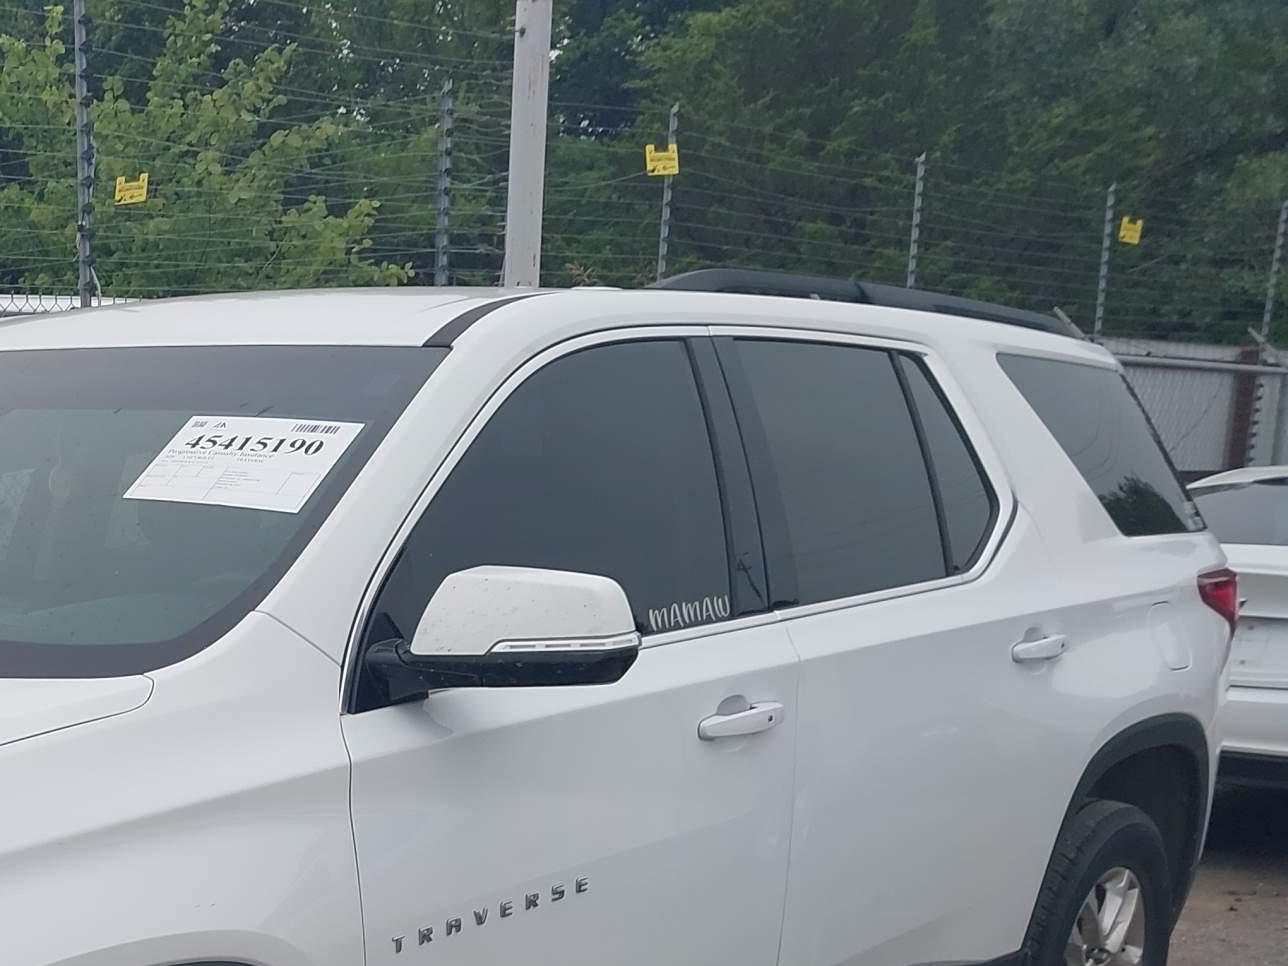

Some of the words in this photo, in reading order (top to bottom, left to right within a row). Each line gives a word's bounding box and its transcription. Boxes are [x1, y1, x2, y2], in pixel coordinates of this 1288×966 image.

[185, 433, 324, 456] 45415190
[648, 594, 731, 632] MAMAW
[391, 876, 590, 954] TRAVERSE
